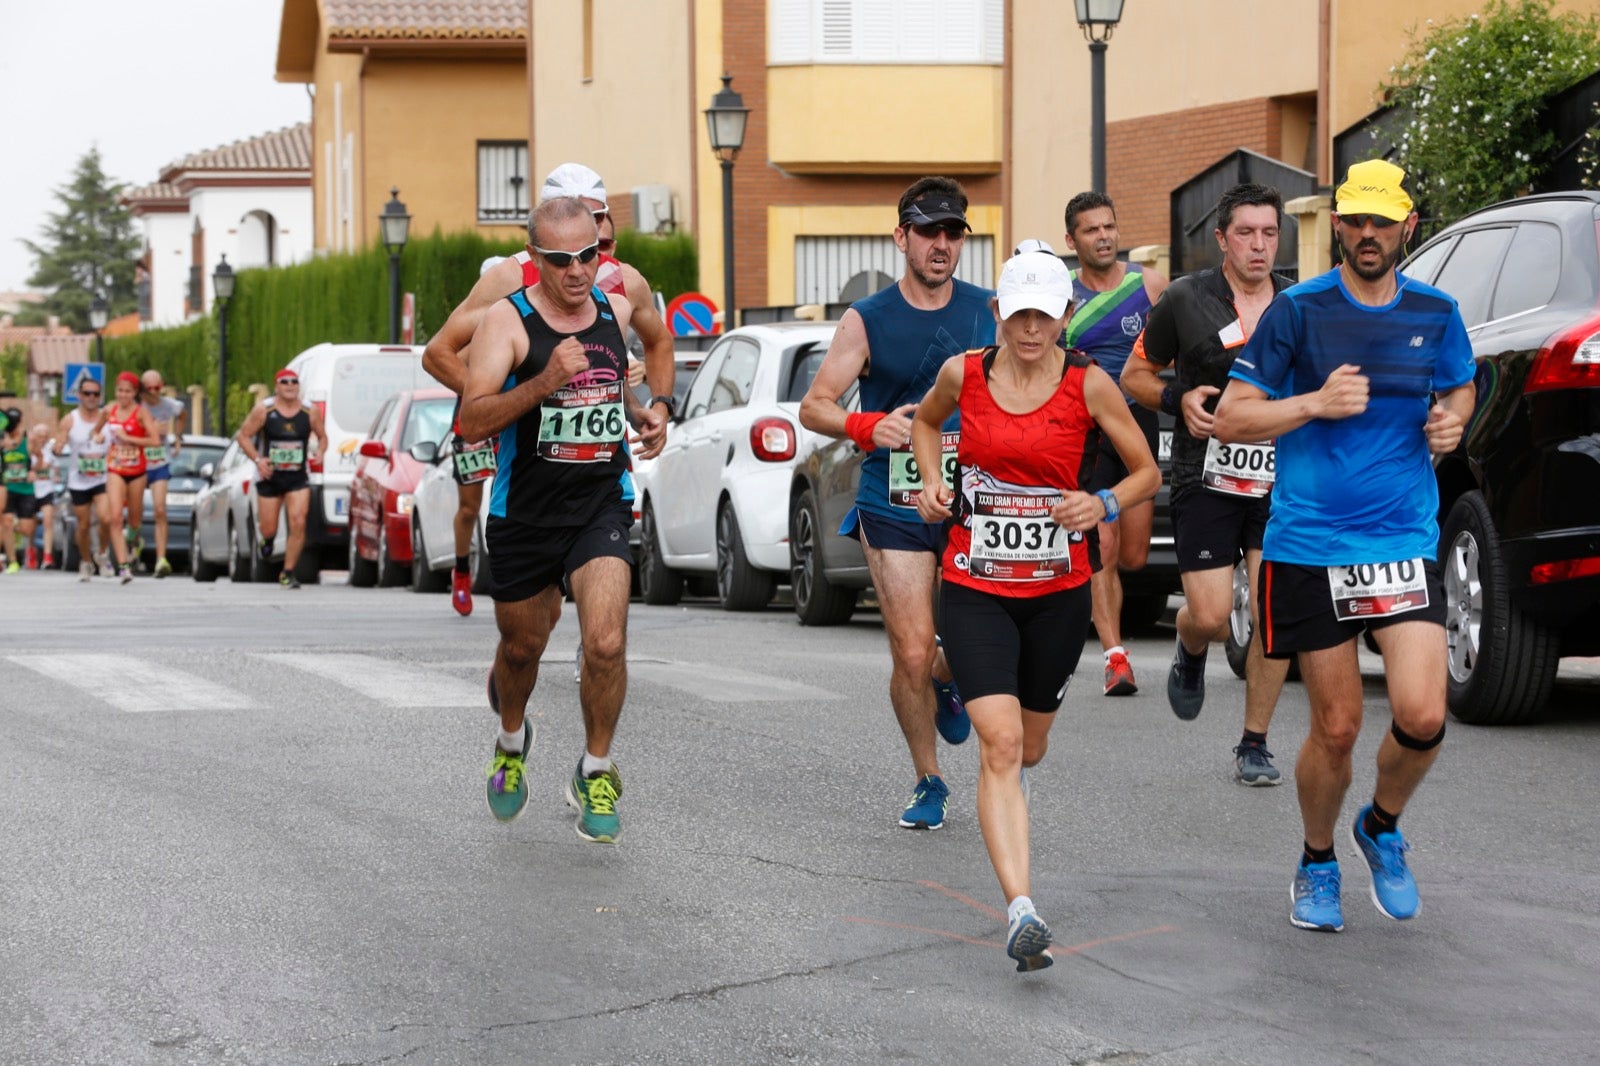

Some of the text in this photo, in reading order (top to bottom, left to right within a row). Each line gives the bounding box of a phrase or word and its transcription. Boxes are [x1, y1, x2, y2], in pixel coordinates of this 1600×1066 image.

[605, 347, 621, 368] VEGA
[549, 407, 623, 437] 1166
[905, 457, 958, 485] 99
[1216, 445, 1275, 473] 3008
[978, 494, 993, 505] XXXII
[994, 495, 1012, 506] GRAN
[1012, 497, 1035, 507] PREMIO
[1036, 497, 1044, 507] DE
[984, 520, 1061, 550] 3037
[995, 551, 1014, 559] PRUEBA
[1342, 558, 1416, 587] 3010
